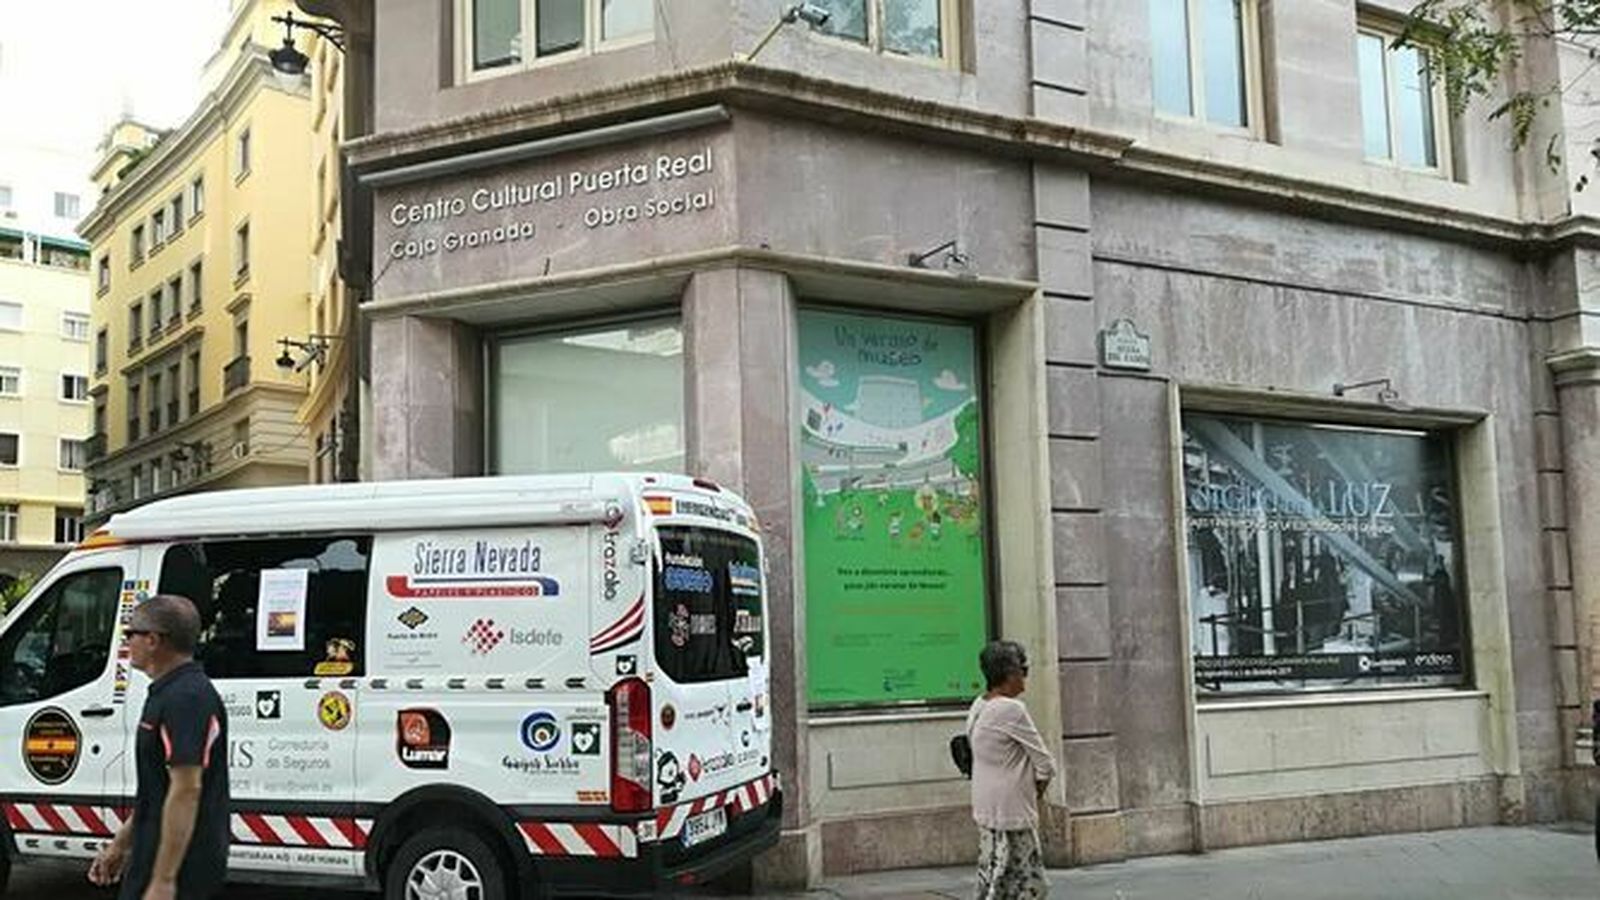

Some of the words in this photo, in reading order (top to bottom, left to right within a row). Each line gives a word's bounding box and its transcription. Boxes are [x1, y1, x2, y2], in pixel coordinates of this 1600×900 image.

[391, 197, 466, 227] Centro
[472, 175, 562, 213] Cultural
[570, 164, 648, 196] Puerta
[656, 149, 713, 182] Real
[584, 206, 638, 230] Obra
[645, 188, 714, 220] Social
[391, 238, 437, 261] Caja
[444, 222, 534, 251] Granada
[1329, 480, 1394, 518] LUZ
[414, 542, 466, 575] Sierra
[474, 540, 541, 574] Nevada
[510, 628, 562, 646] Isdefe
[229, 740, 255, 769] IS
[283, 756, 330, 775] Seguros
